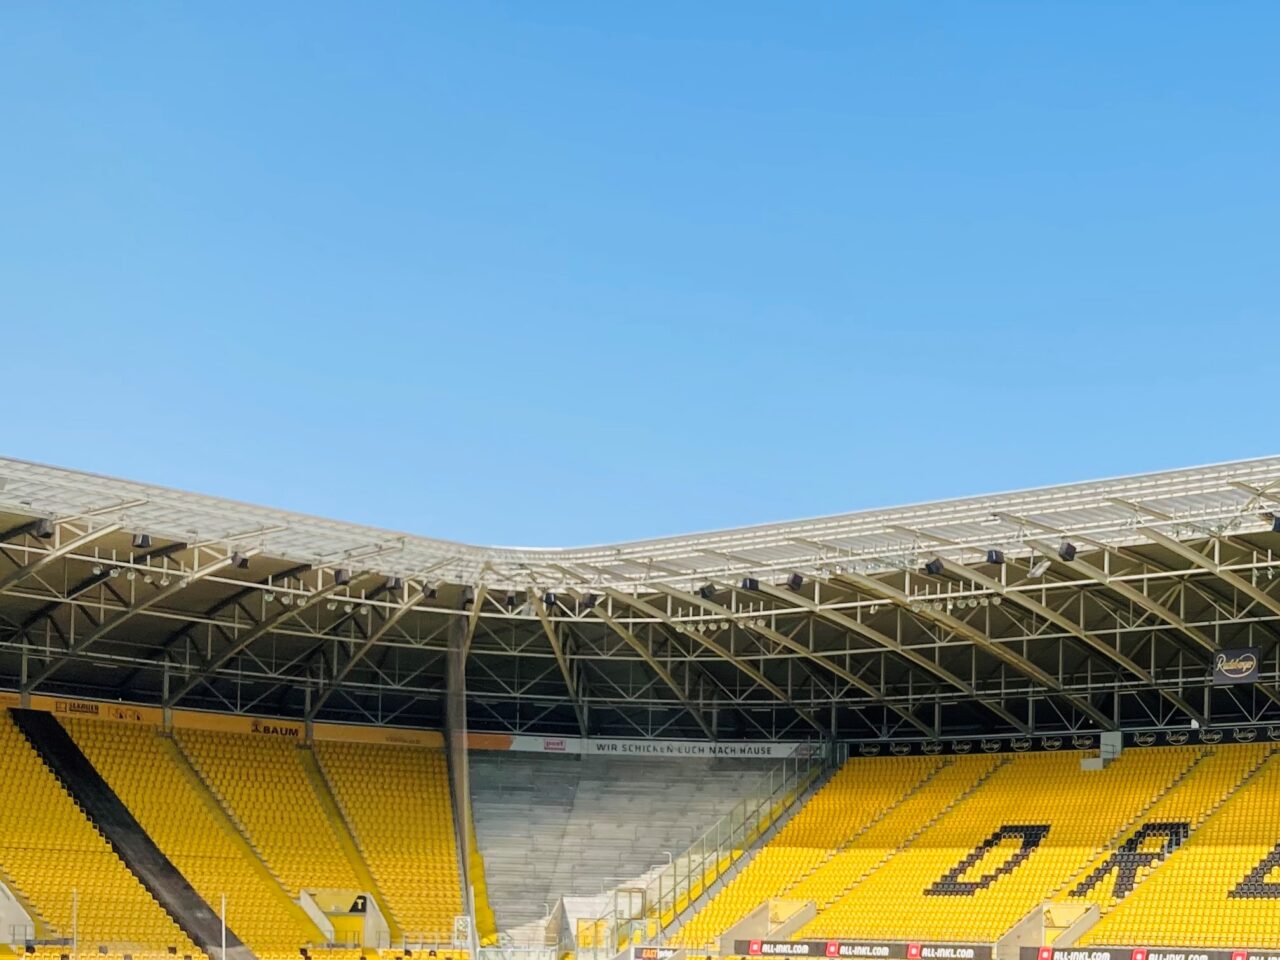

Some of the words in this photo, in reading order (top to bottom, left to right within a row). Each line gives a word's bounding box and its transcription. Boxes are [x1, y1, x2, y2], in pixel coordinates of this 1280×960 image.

[263, 725, 299, 737] BAUM
[596, 743, 618, 752] WIR
[709, 745, 737, 755] NACH
[357, 899, 364, 909] T
